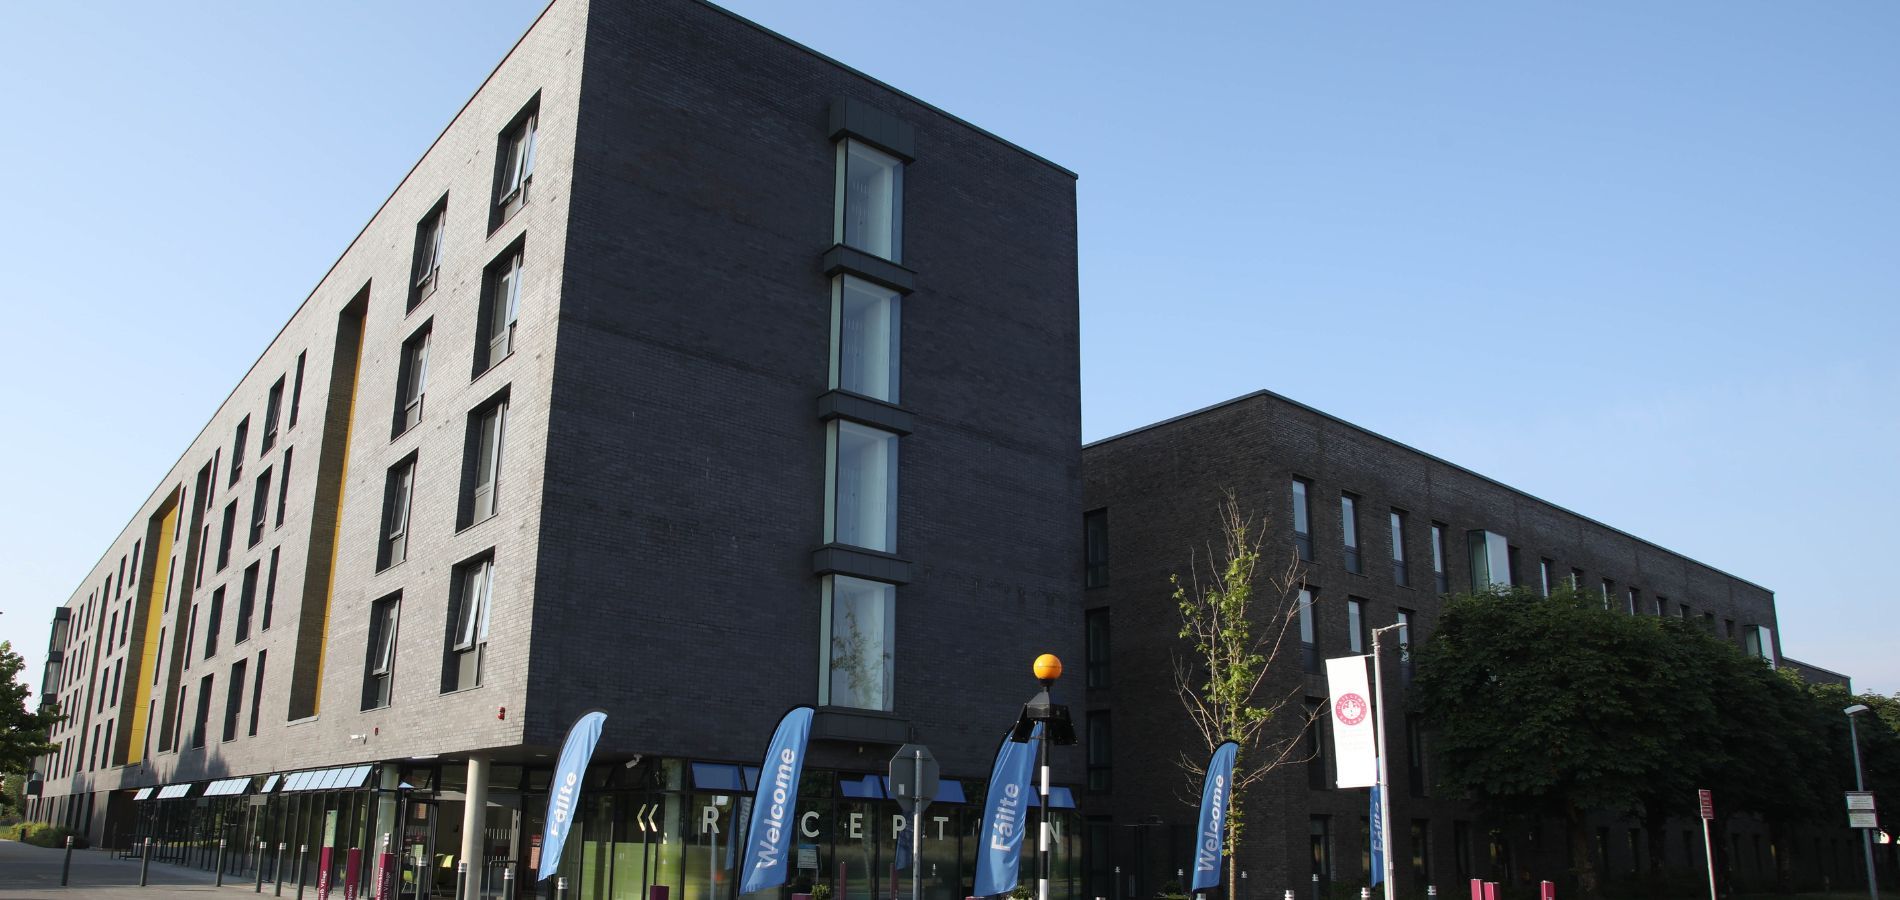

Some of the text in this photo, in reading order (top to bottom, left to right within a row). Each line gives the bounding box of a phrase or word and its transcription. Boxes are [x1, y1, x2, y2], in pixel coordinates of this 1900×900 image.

[756, 748, 795, 869] Welcome
[991, 783, 1019, 852] Fáilte
[1198, 774, 1224, 872] Welcome
